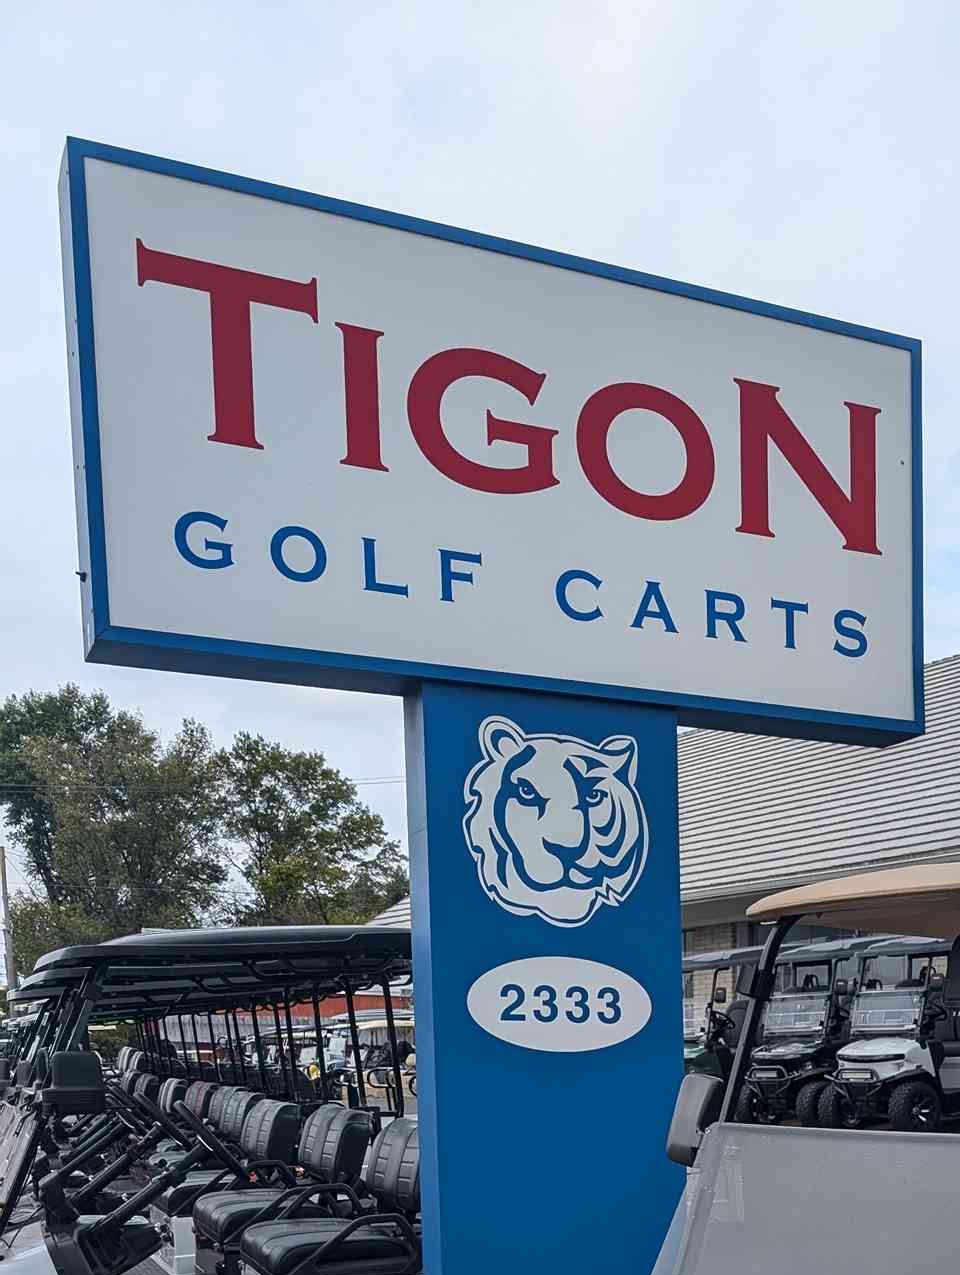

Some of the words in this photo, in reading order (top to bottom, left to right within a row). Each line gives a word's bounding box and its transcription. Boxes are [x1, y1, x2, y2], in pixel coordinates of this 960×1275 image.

[136, 238, 882, 555] TIGON
[174, 511, 482, 602] GOLF
[555, 570, 868, 657] CARTS
[500, 983, 622, 1024] 2333
